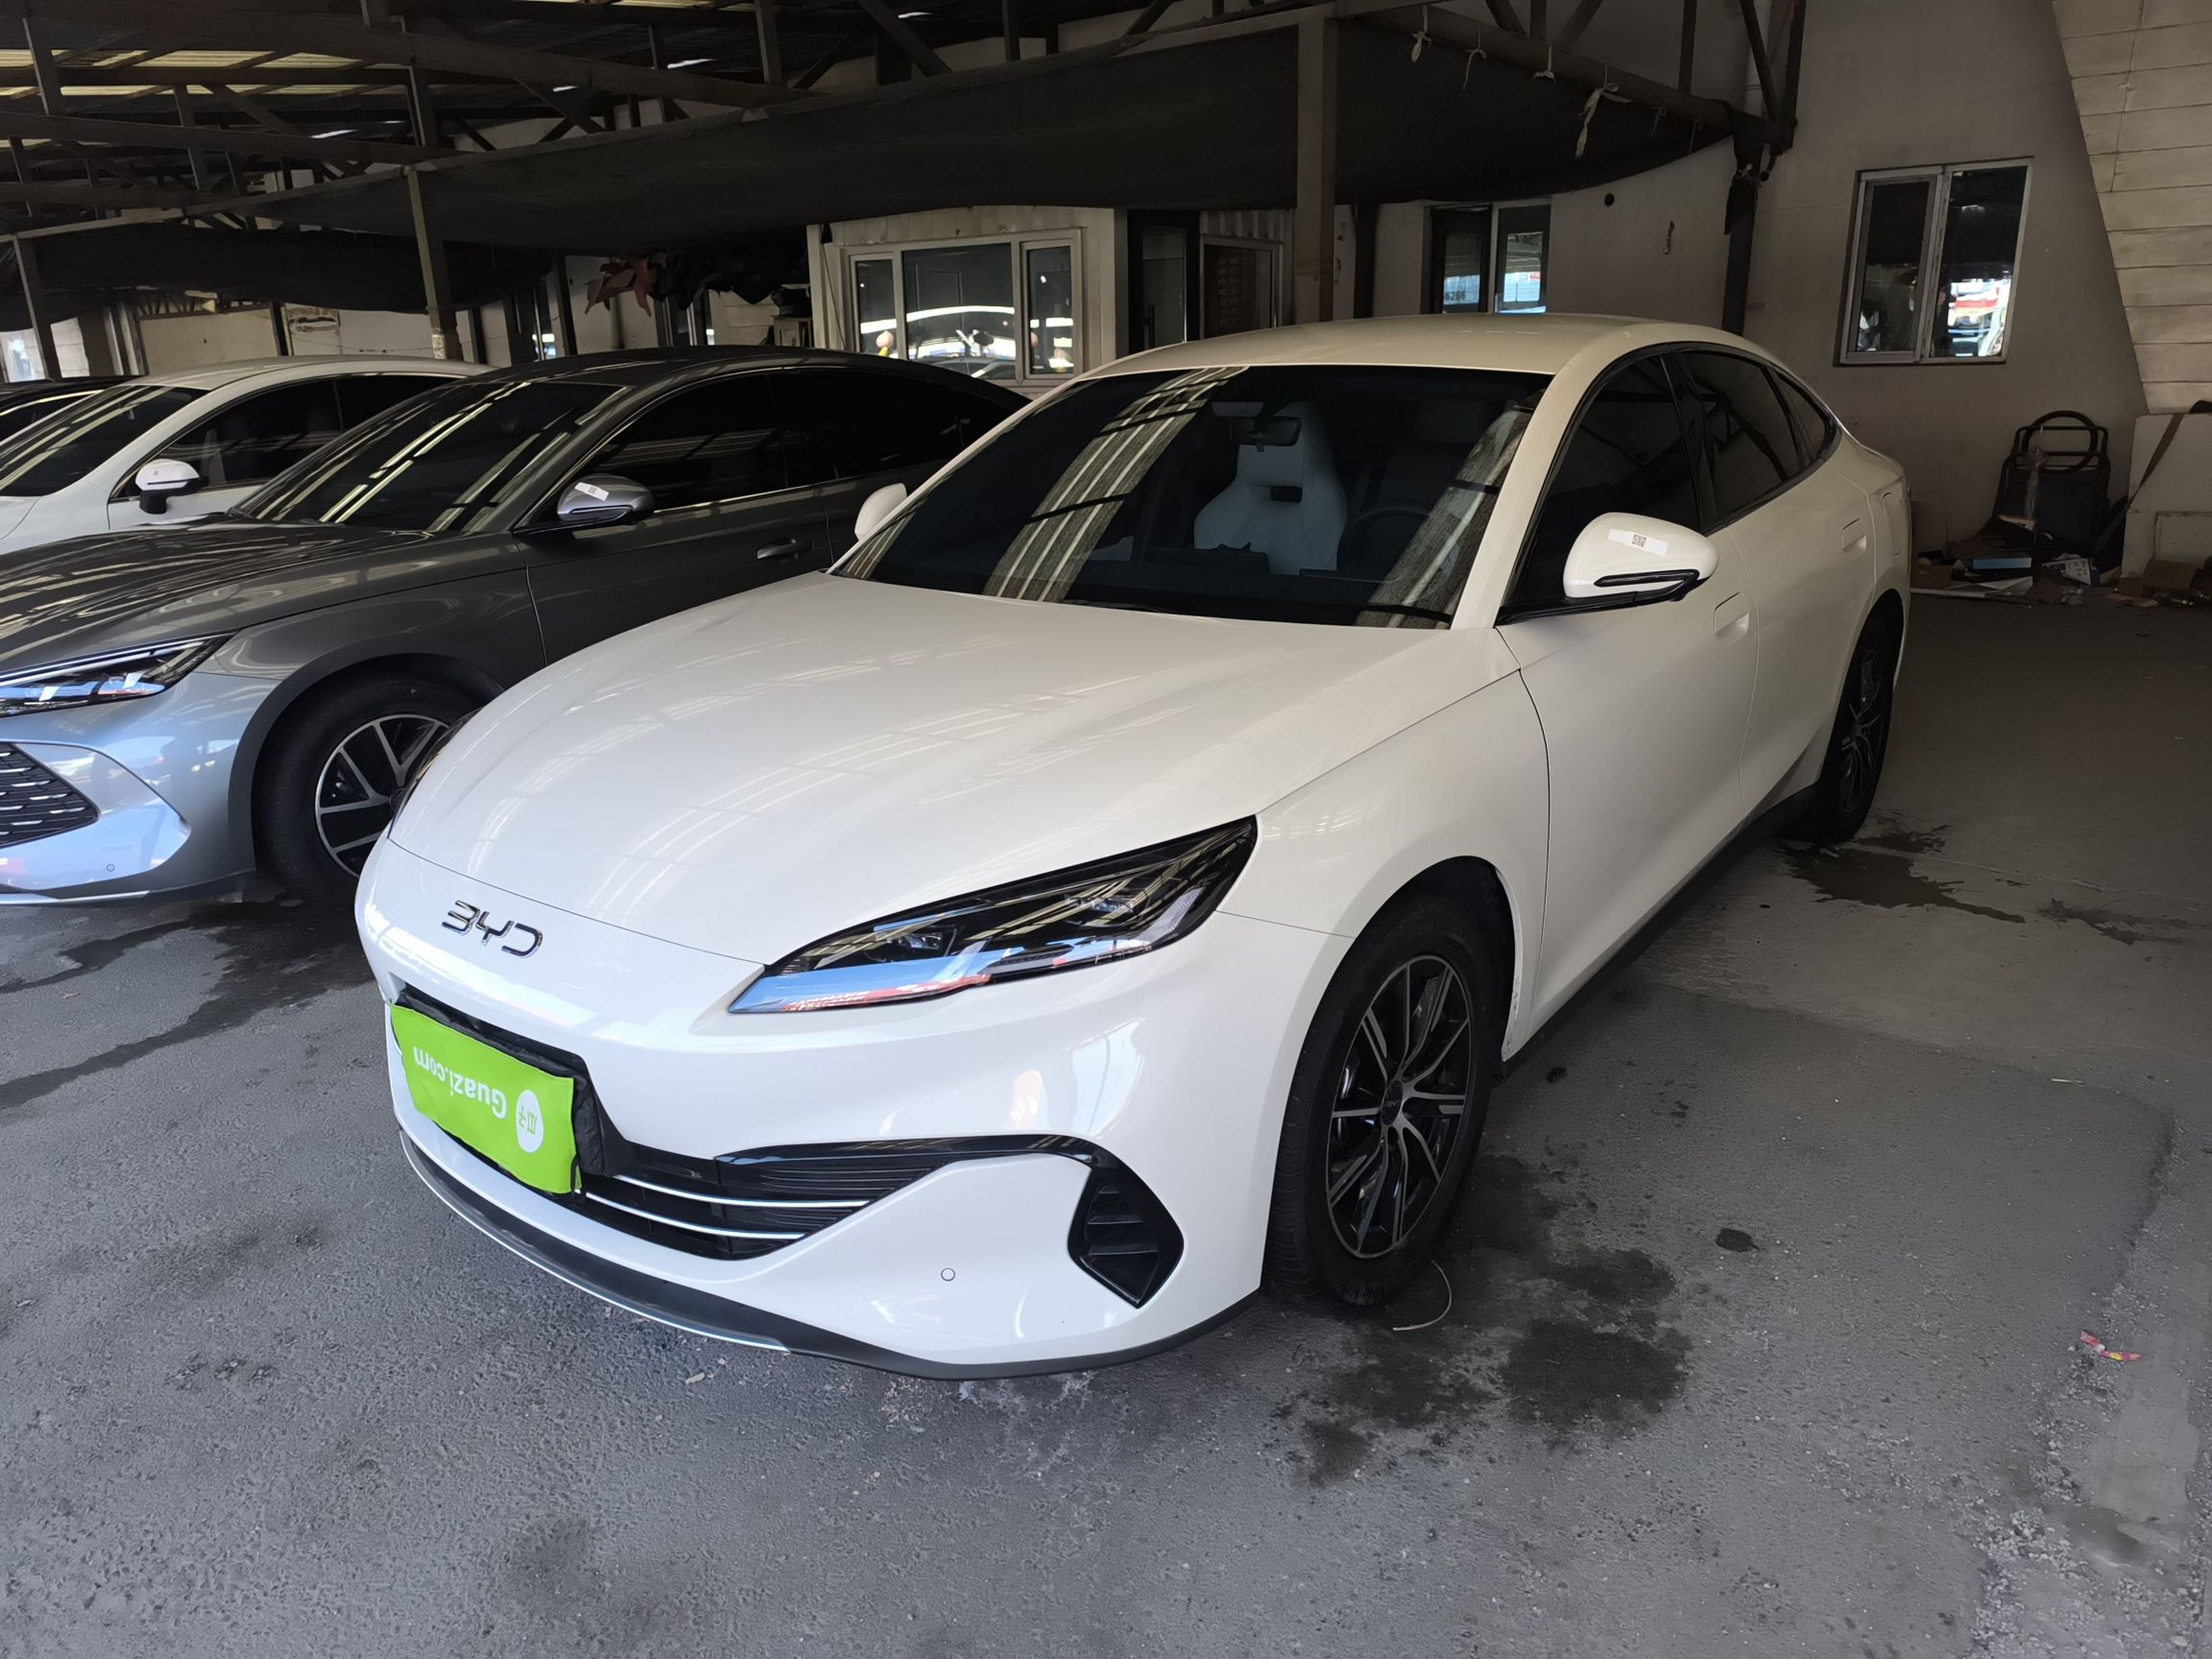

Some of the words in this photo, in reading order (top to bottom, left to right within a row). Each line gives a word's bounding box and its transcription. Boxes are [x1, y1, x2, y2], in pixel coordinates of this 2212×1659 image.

[442, 900, 543, 959] BYD
[412, 1046, 507, 1120] Guazi.com
[518, 1105, 537, 1135] 瓜子
